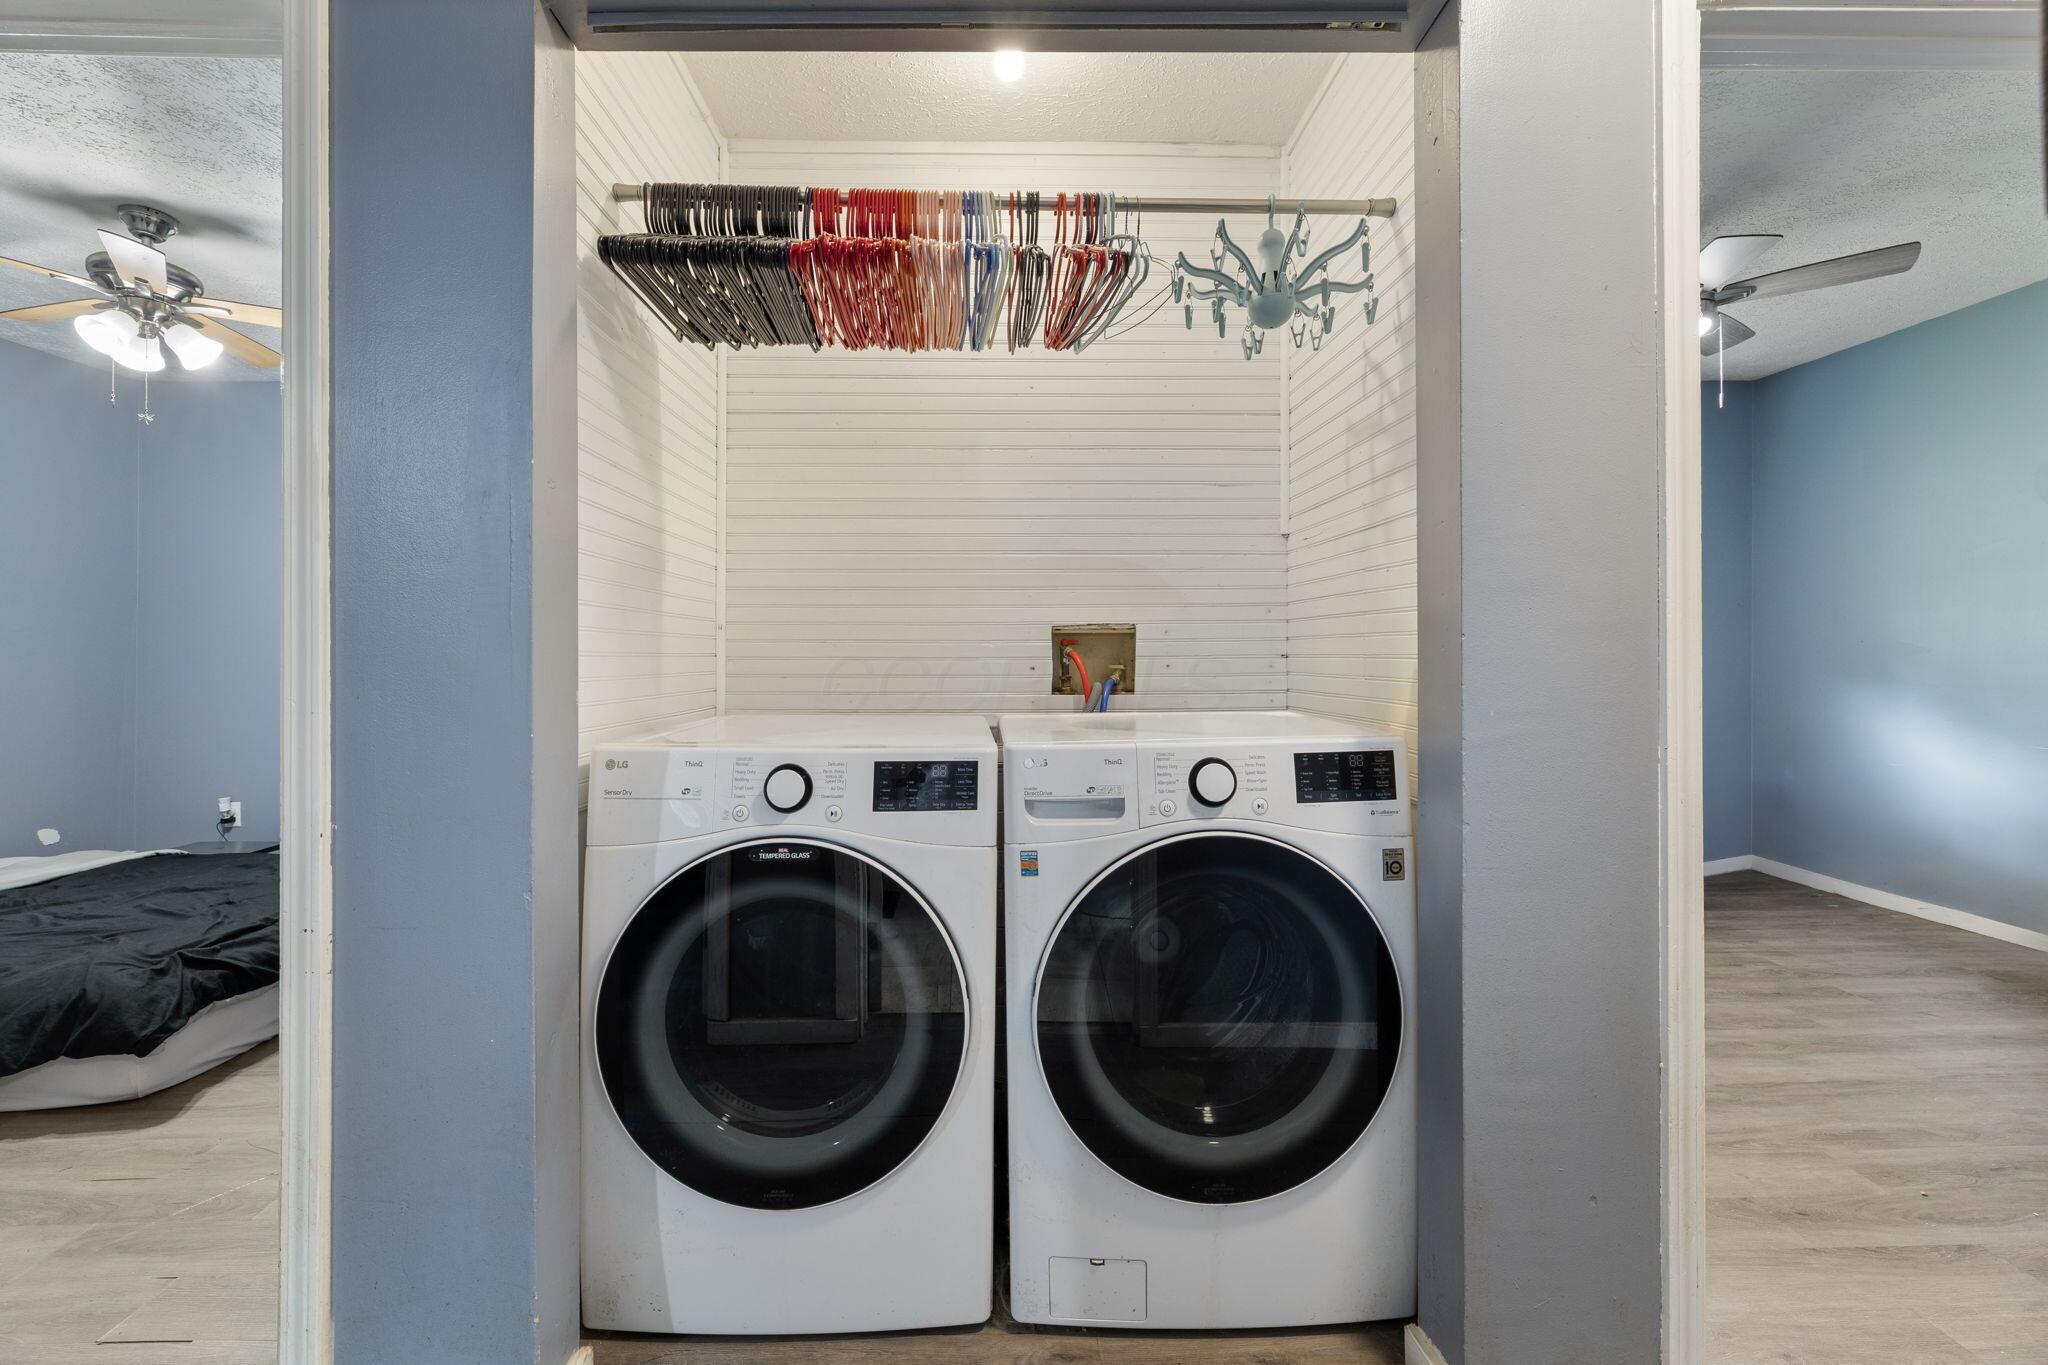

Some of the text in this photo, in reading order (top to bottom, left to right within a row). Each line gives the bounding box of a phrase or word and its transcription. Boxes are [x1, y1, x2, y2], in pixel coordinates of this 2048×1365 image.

[685, 760, 703, 768] ThinQ
[1103, 758, 1123, 766] ThinQ
[1384, 860, 1403, 876] 10
